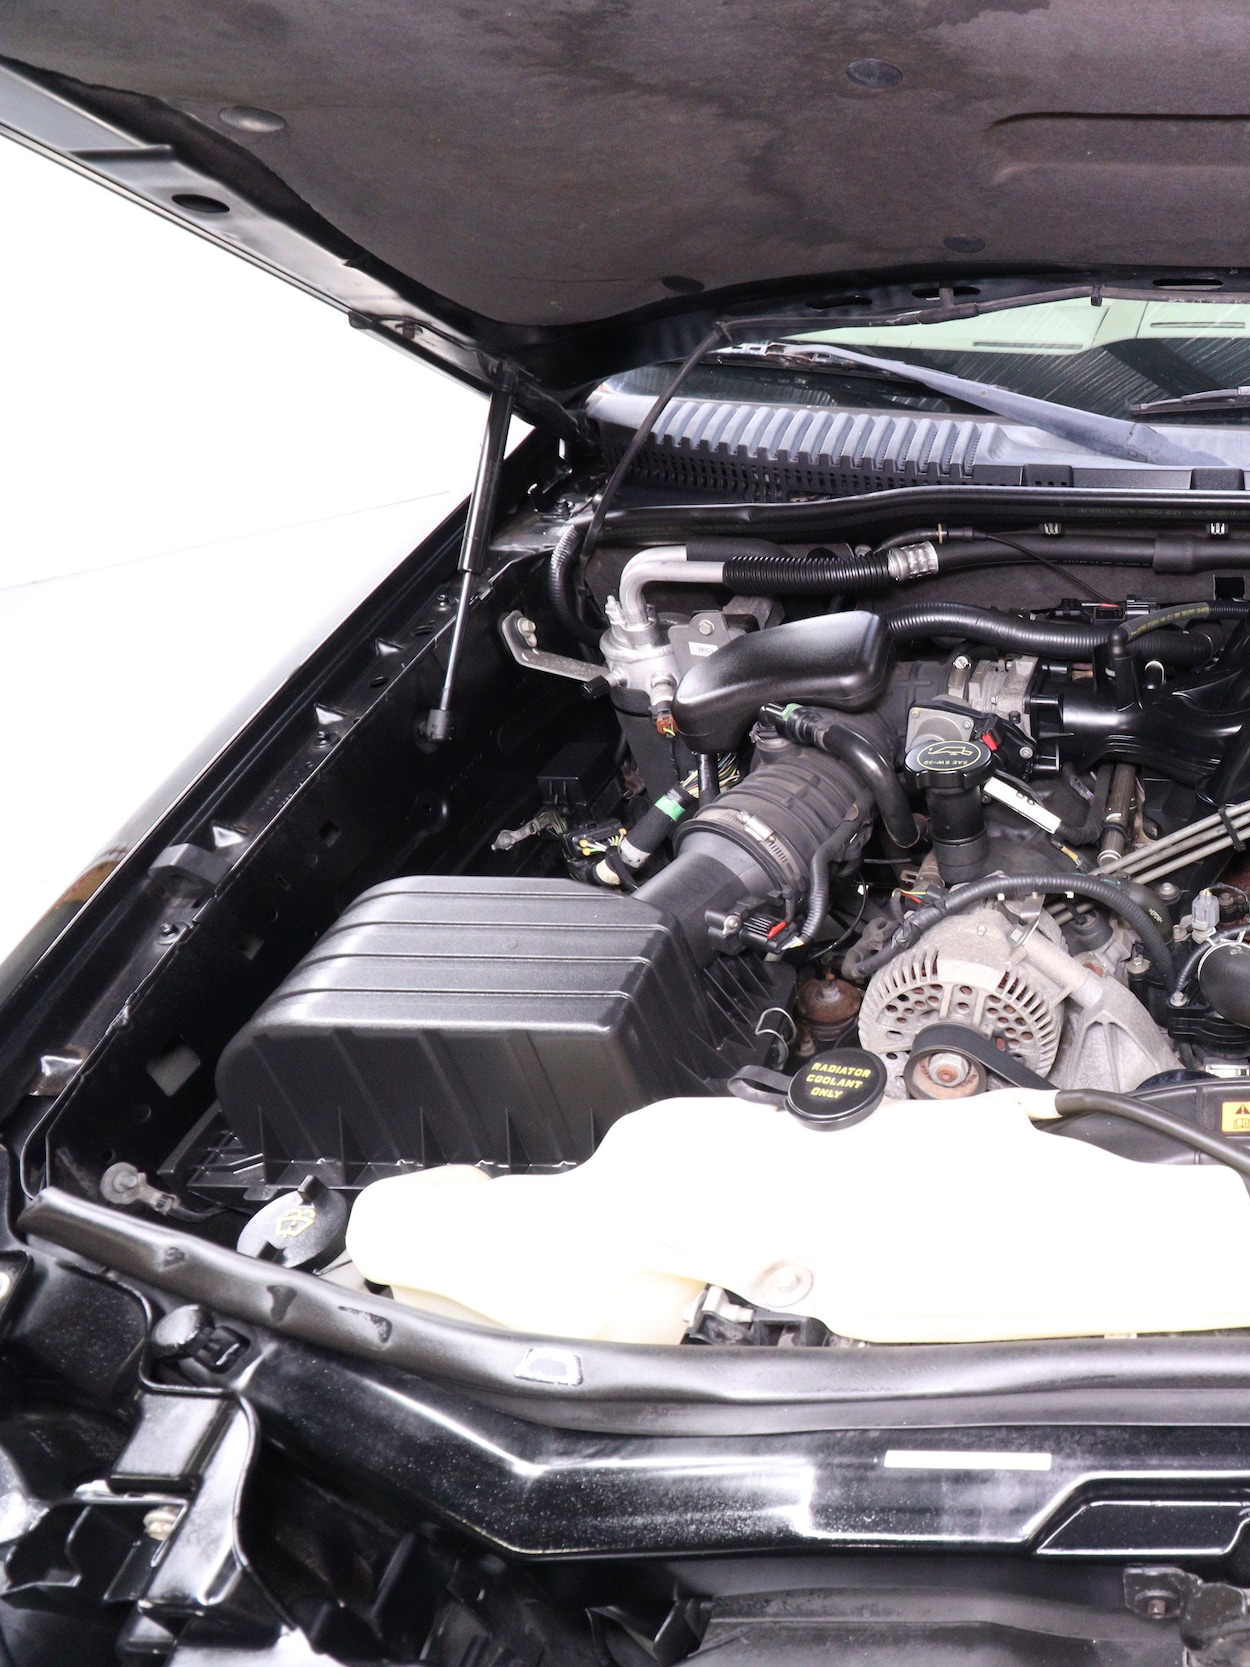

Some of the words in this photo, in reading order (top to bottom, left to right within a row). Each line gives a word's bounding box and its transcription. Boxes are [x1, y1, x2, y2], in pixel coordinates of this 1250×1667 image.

[811, 1062, 872, 1078] RADIATOR
[805, 1074, 864, 1089] COOLANT
[810, 1087, 844, 1099] ONLY
